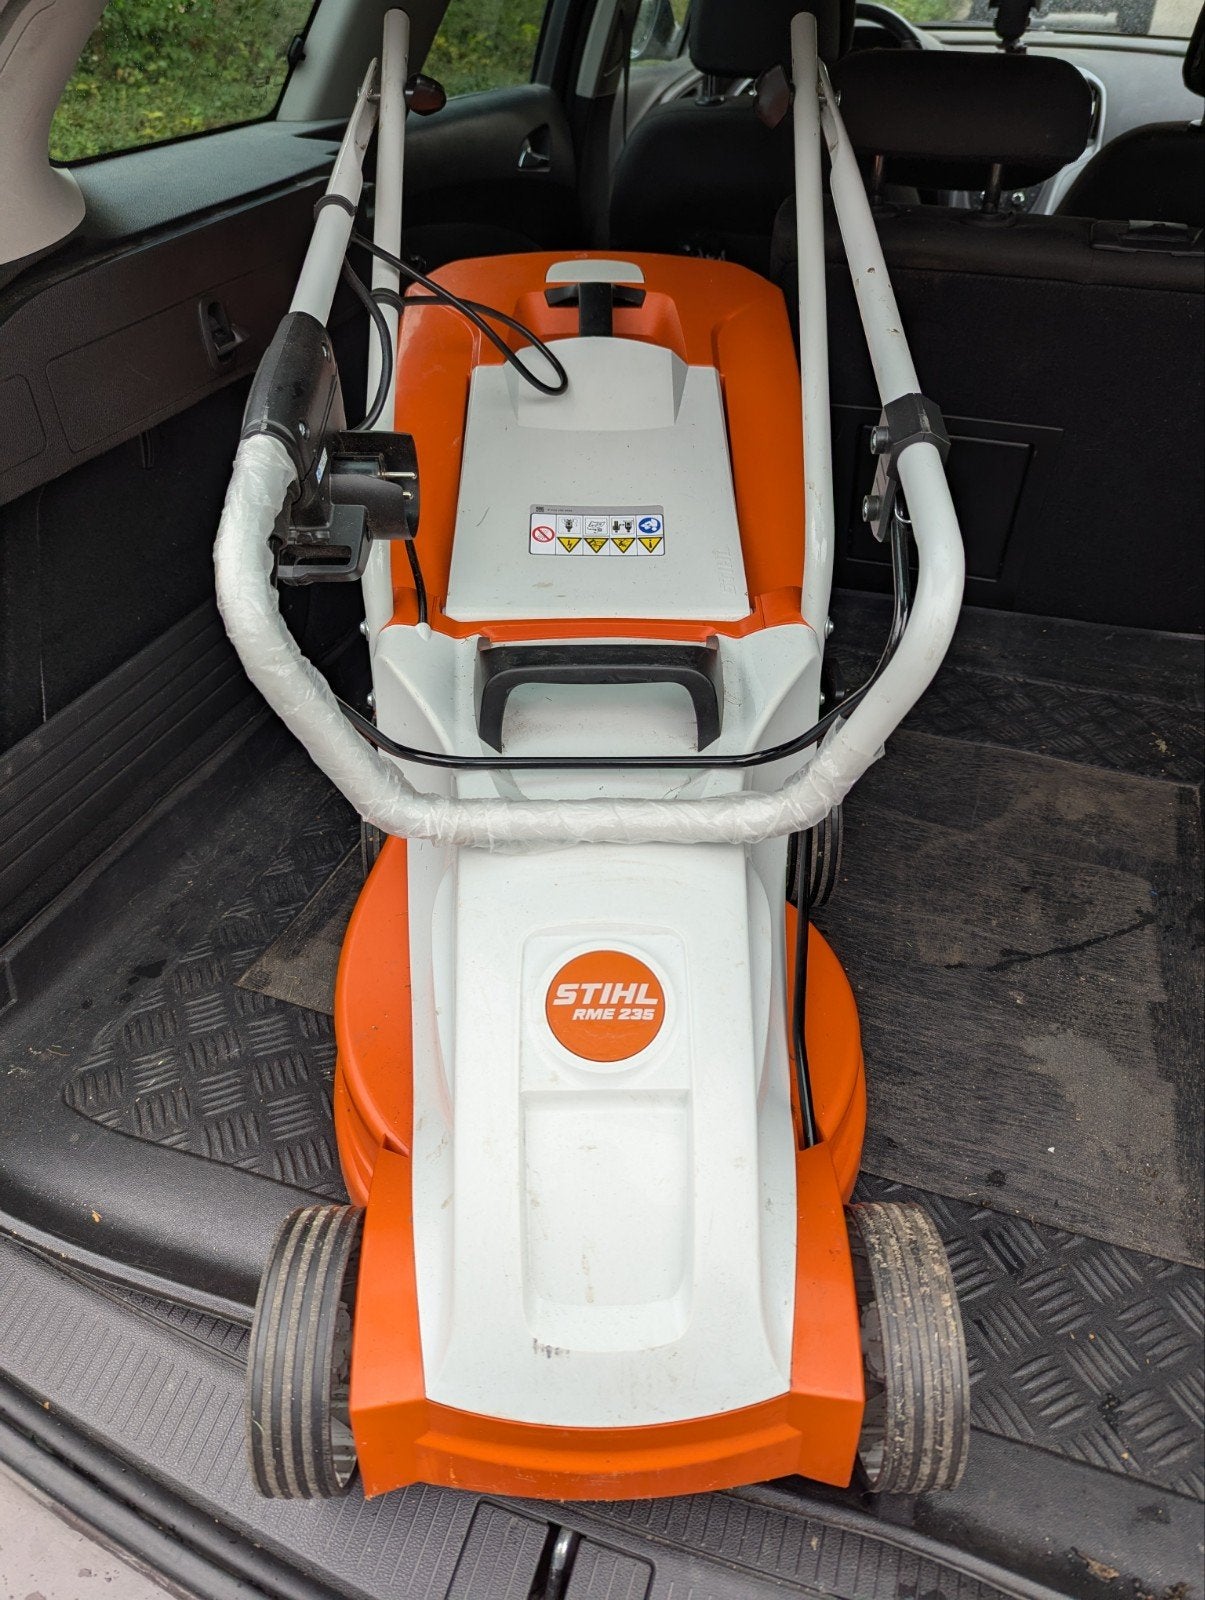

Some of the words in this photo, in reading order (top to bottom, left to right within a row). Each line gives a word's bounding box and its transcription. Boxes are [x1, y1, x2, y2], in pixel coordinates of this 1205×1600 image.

[552, 983, 659, 1005] STIHL
[572, 1008, 616, 1021] RME
[617, 1008, 656, 1021] 235
